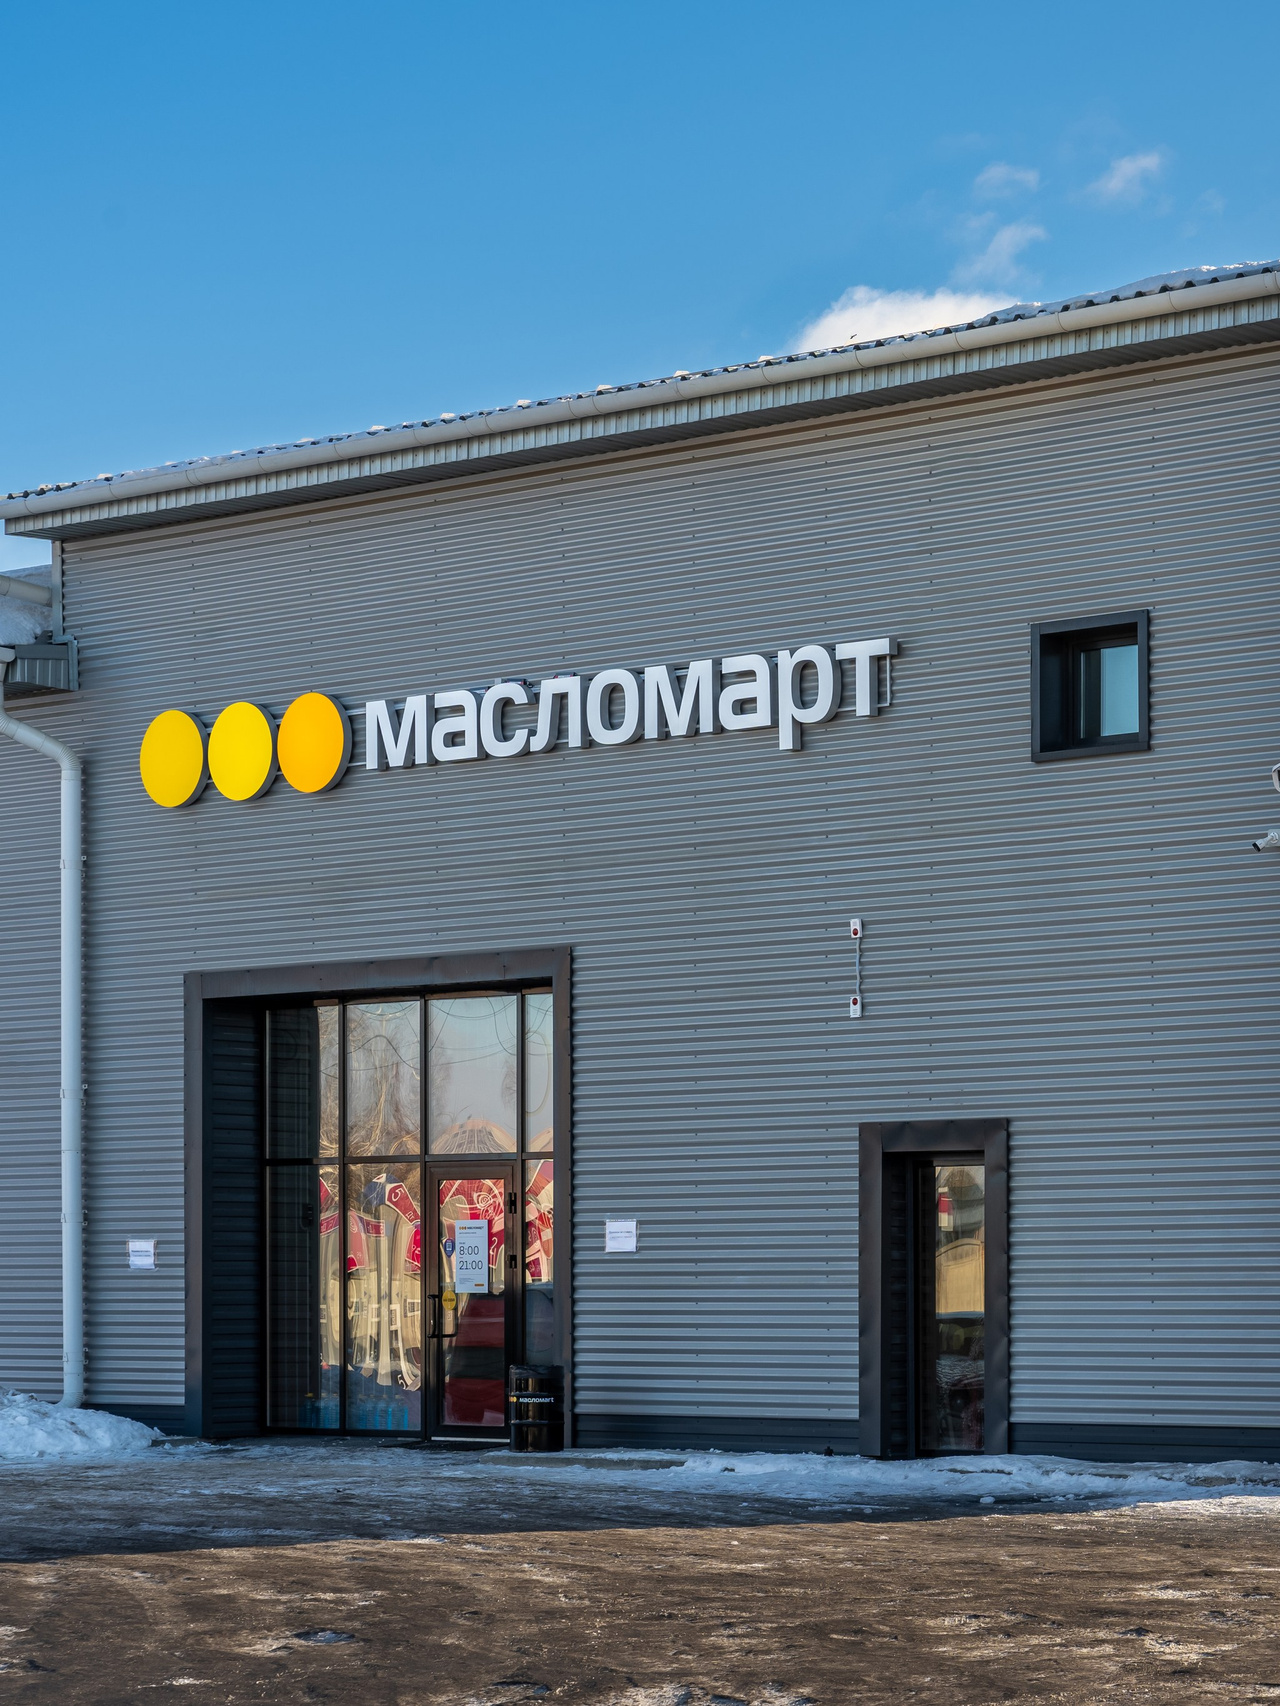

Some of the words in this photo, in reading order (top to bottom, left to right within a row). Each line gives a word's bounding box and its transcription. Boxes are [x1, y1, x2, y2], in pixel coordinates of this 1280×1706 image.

[365, 638, 897, 770] масломарт
[459, 1245, 480, 1256] 8:00
[458, 1260, 484, 1270] 21:00
